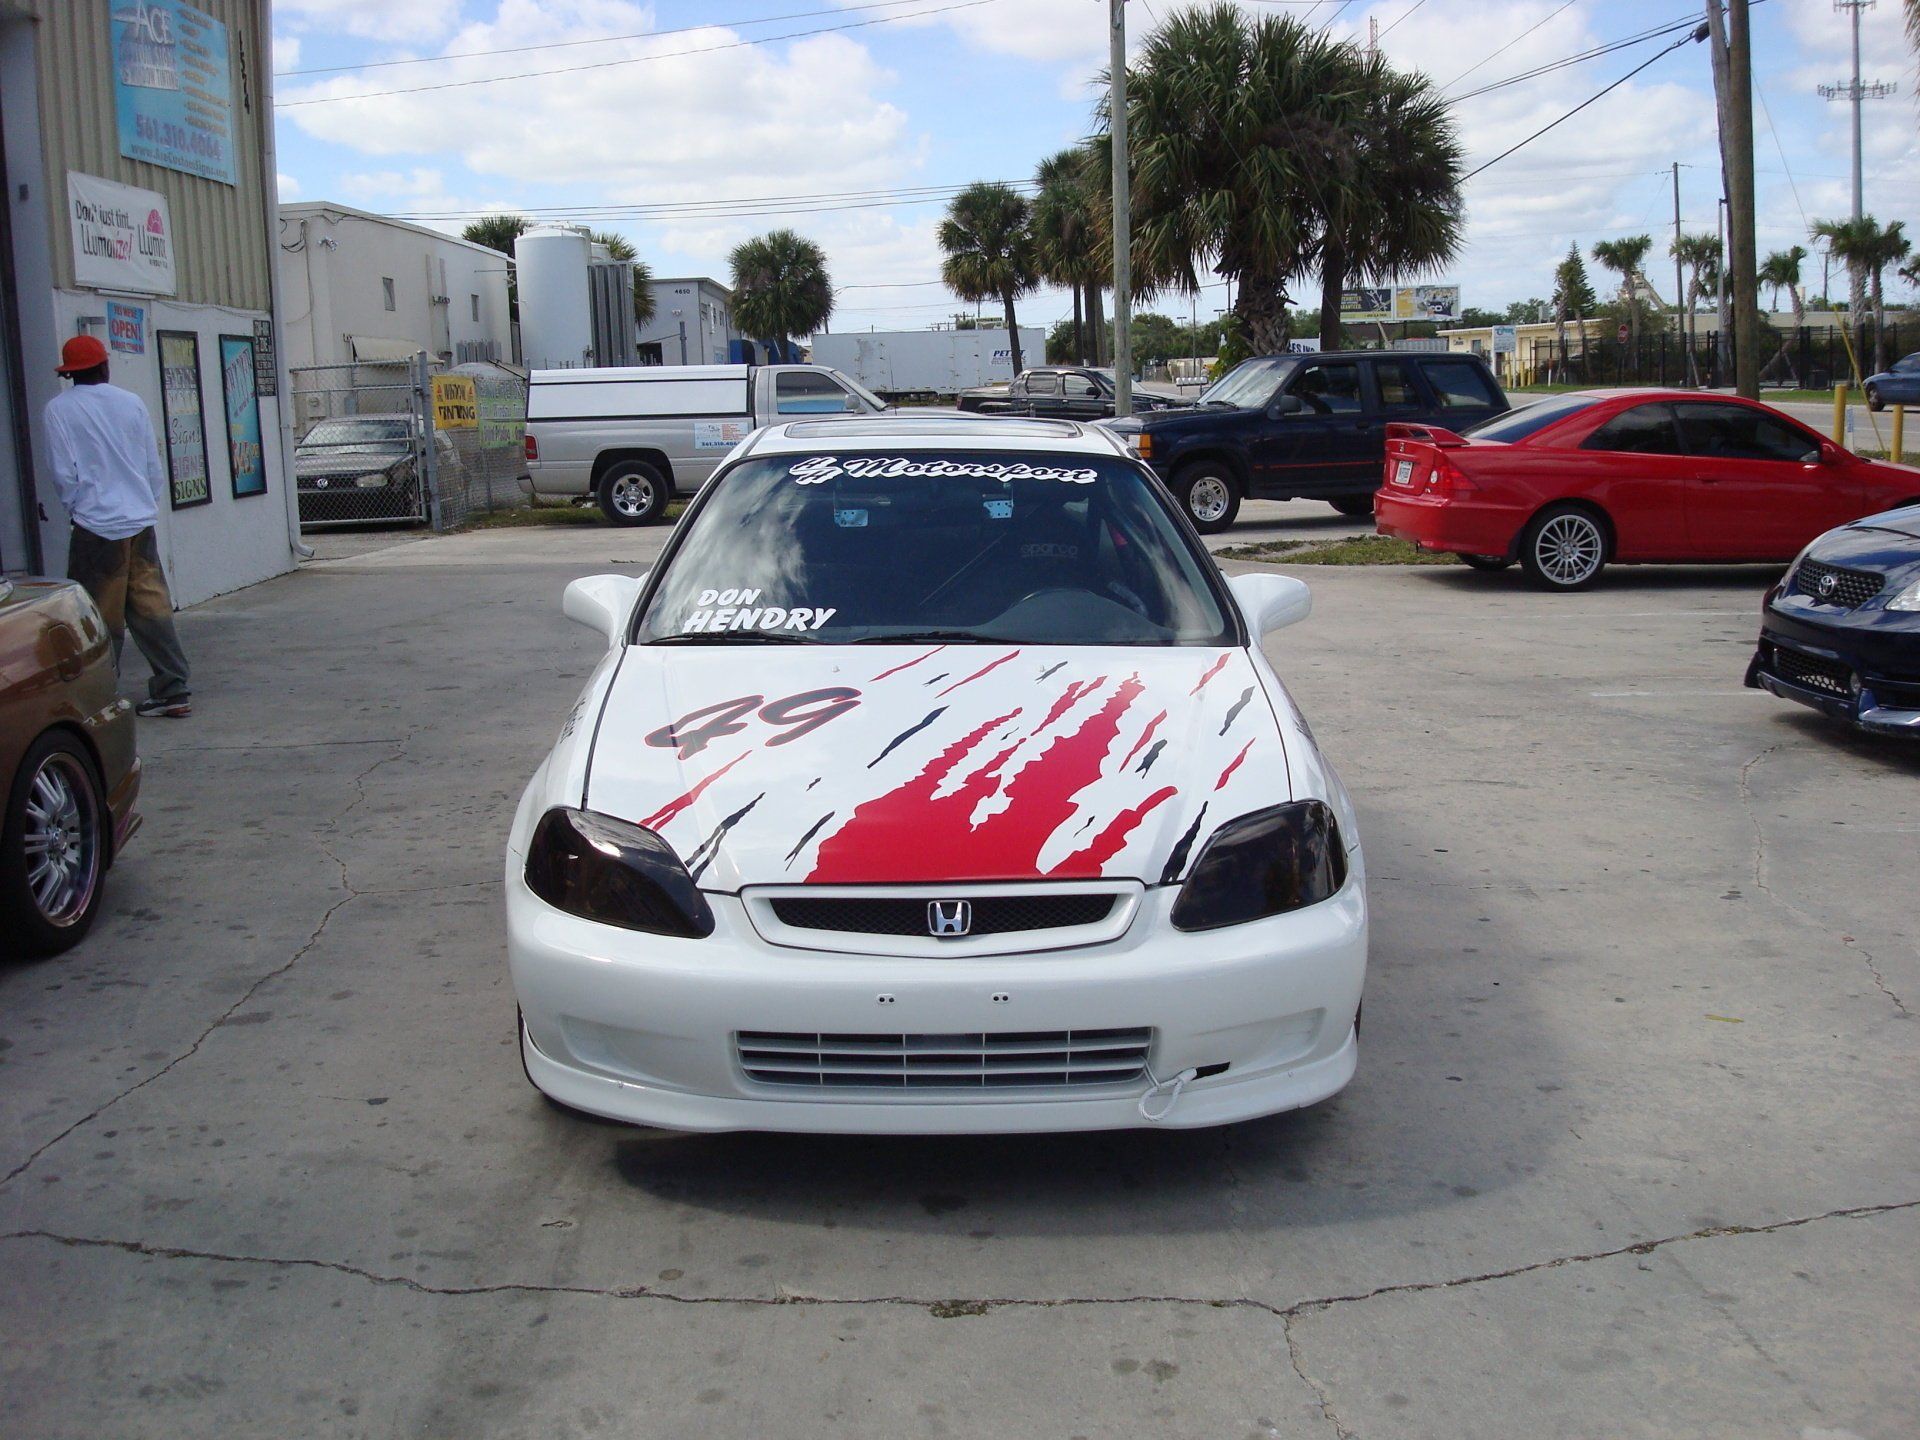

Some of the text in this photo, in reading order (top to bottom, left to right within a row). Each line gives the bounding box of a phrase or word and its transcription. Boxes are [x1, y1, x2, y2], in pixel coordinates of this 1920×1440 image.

[112, 0, 175, 45] ACE
[76, 200, 97, 223] Don't
[99, 204, 115, 228] just
[843, 458, 1097, 484] Motorsport
[174, 479, 207, 500] SIGNS
[697, 588, 761, 607] DON
[682, 607, 837, 633] HENDRY
[644, 686, 862, 760] 49
